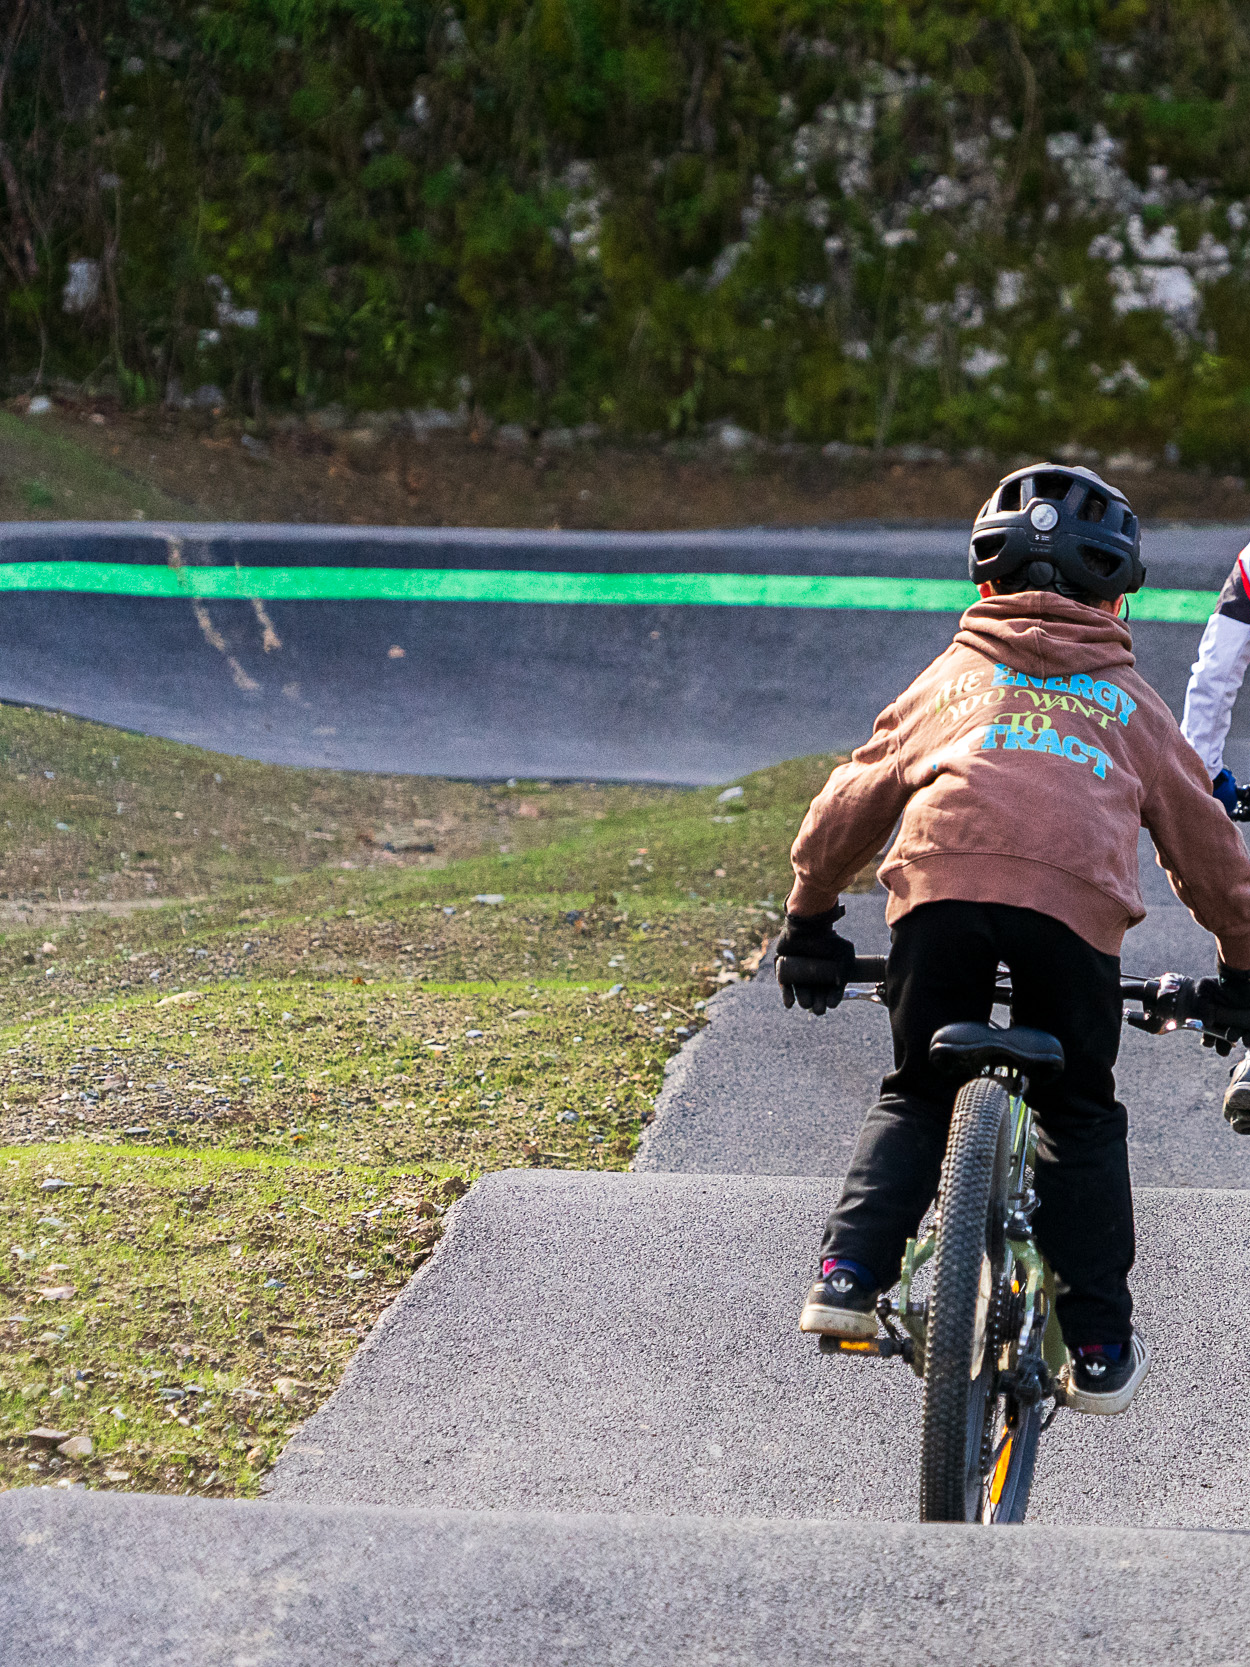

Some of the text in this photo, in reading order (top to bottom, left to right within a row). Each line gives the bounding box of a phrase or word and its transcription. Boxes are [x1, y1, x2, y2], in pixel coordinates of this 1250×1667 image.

[991, 663, 1138, 727] ENERGY
[1014, 689, 1117, 730] WANT
[994, 710, 1052, 734] TO
